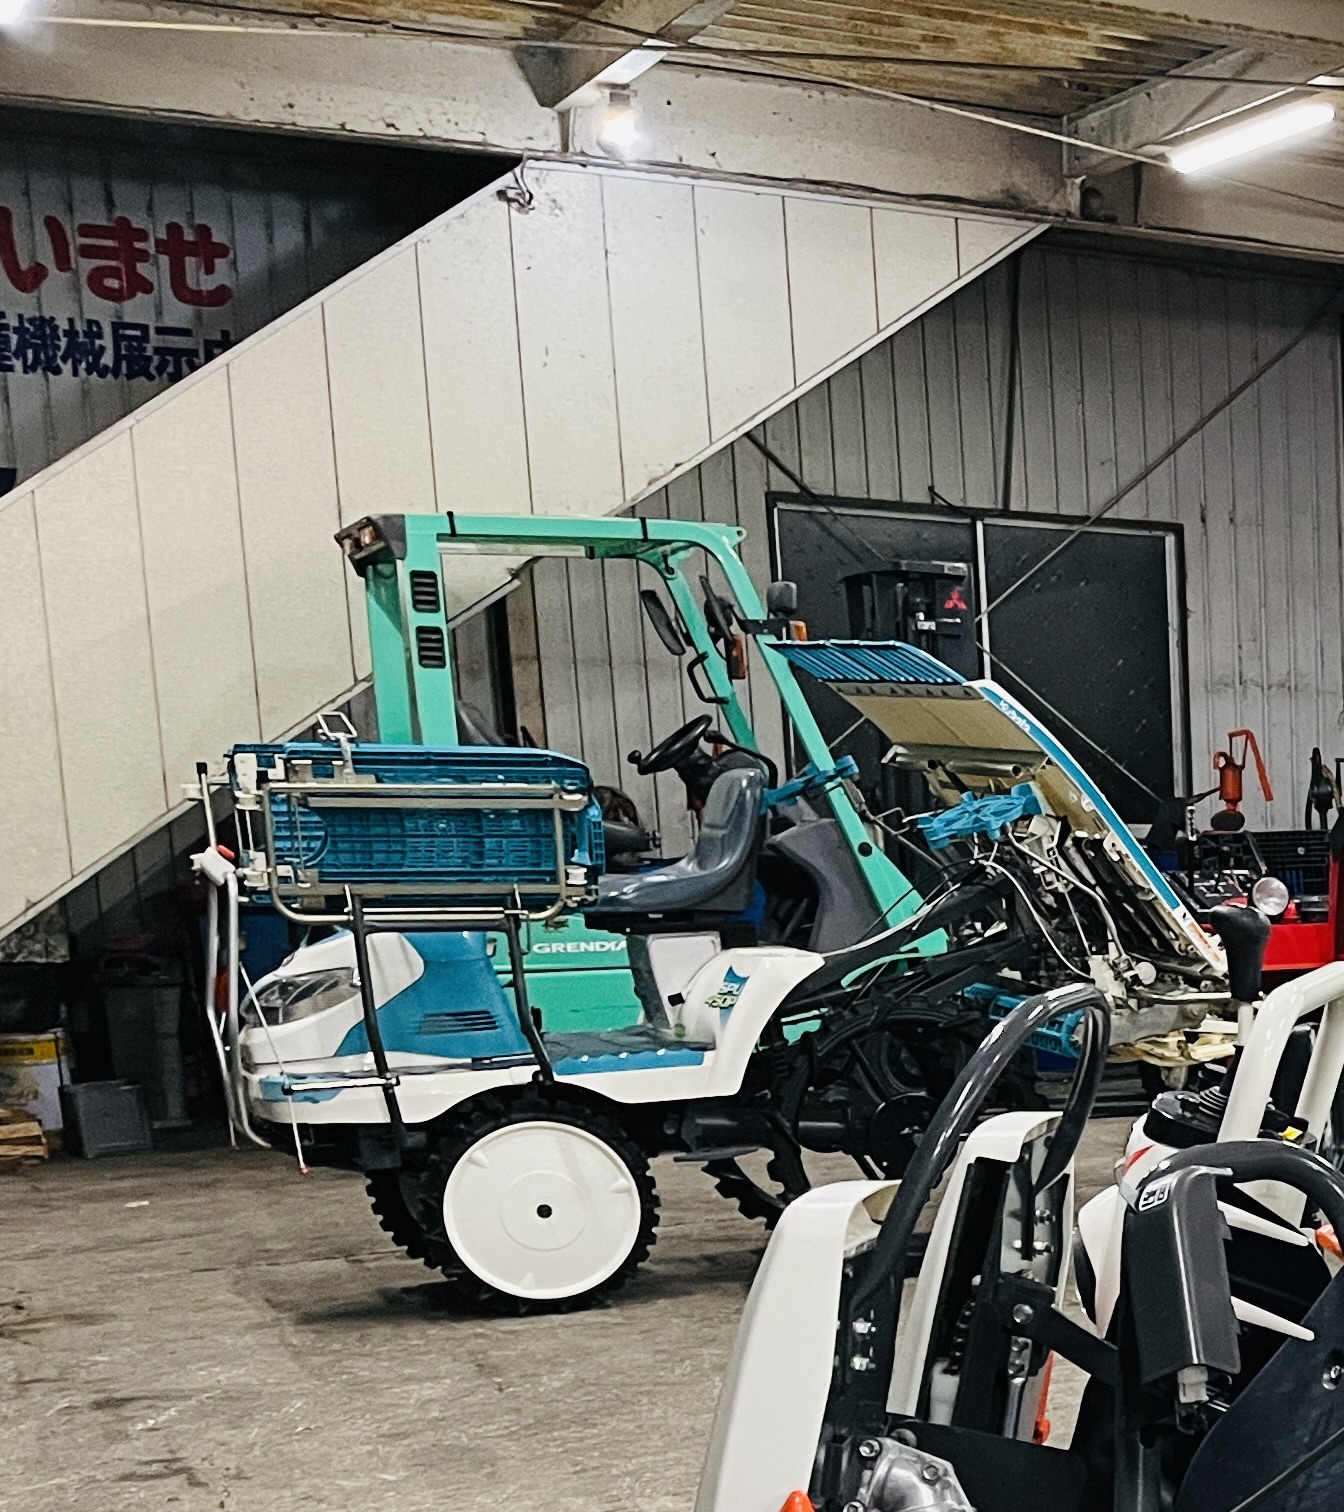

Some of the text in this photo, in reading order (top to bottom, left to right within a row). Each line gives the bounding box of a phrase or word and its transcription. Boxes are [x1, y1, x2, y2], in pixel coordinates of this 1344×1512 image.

[0, 205, 233, 308] いませ
[0, 312, 232, 382] 機械展示
